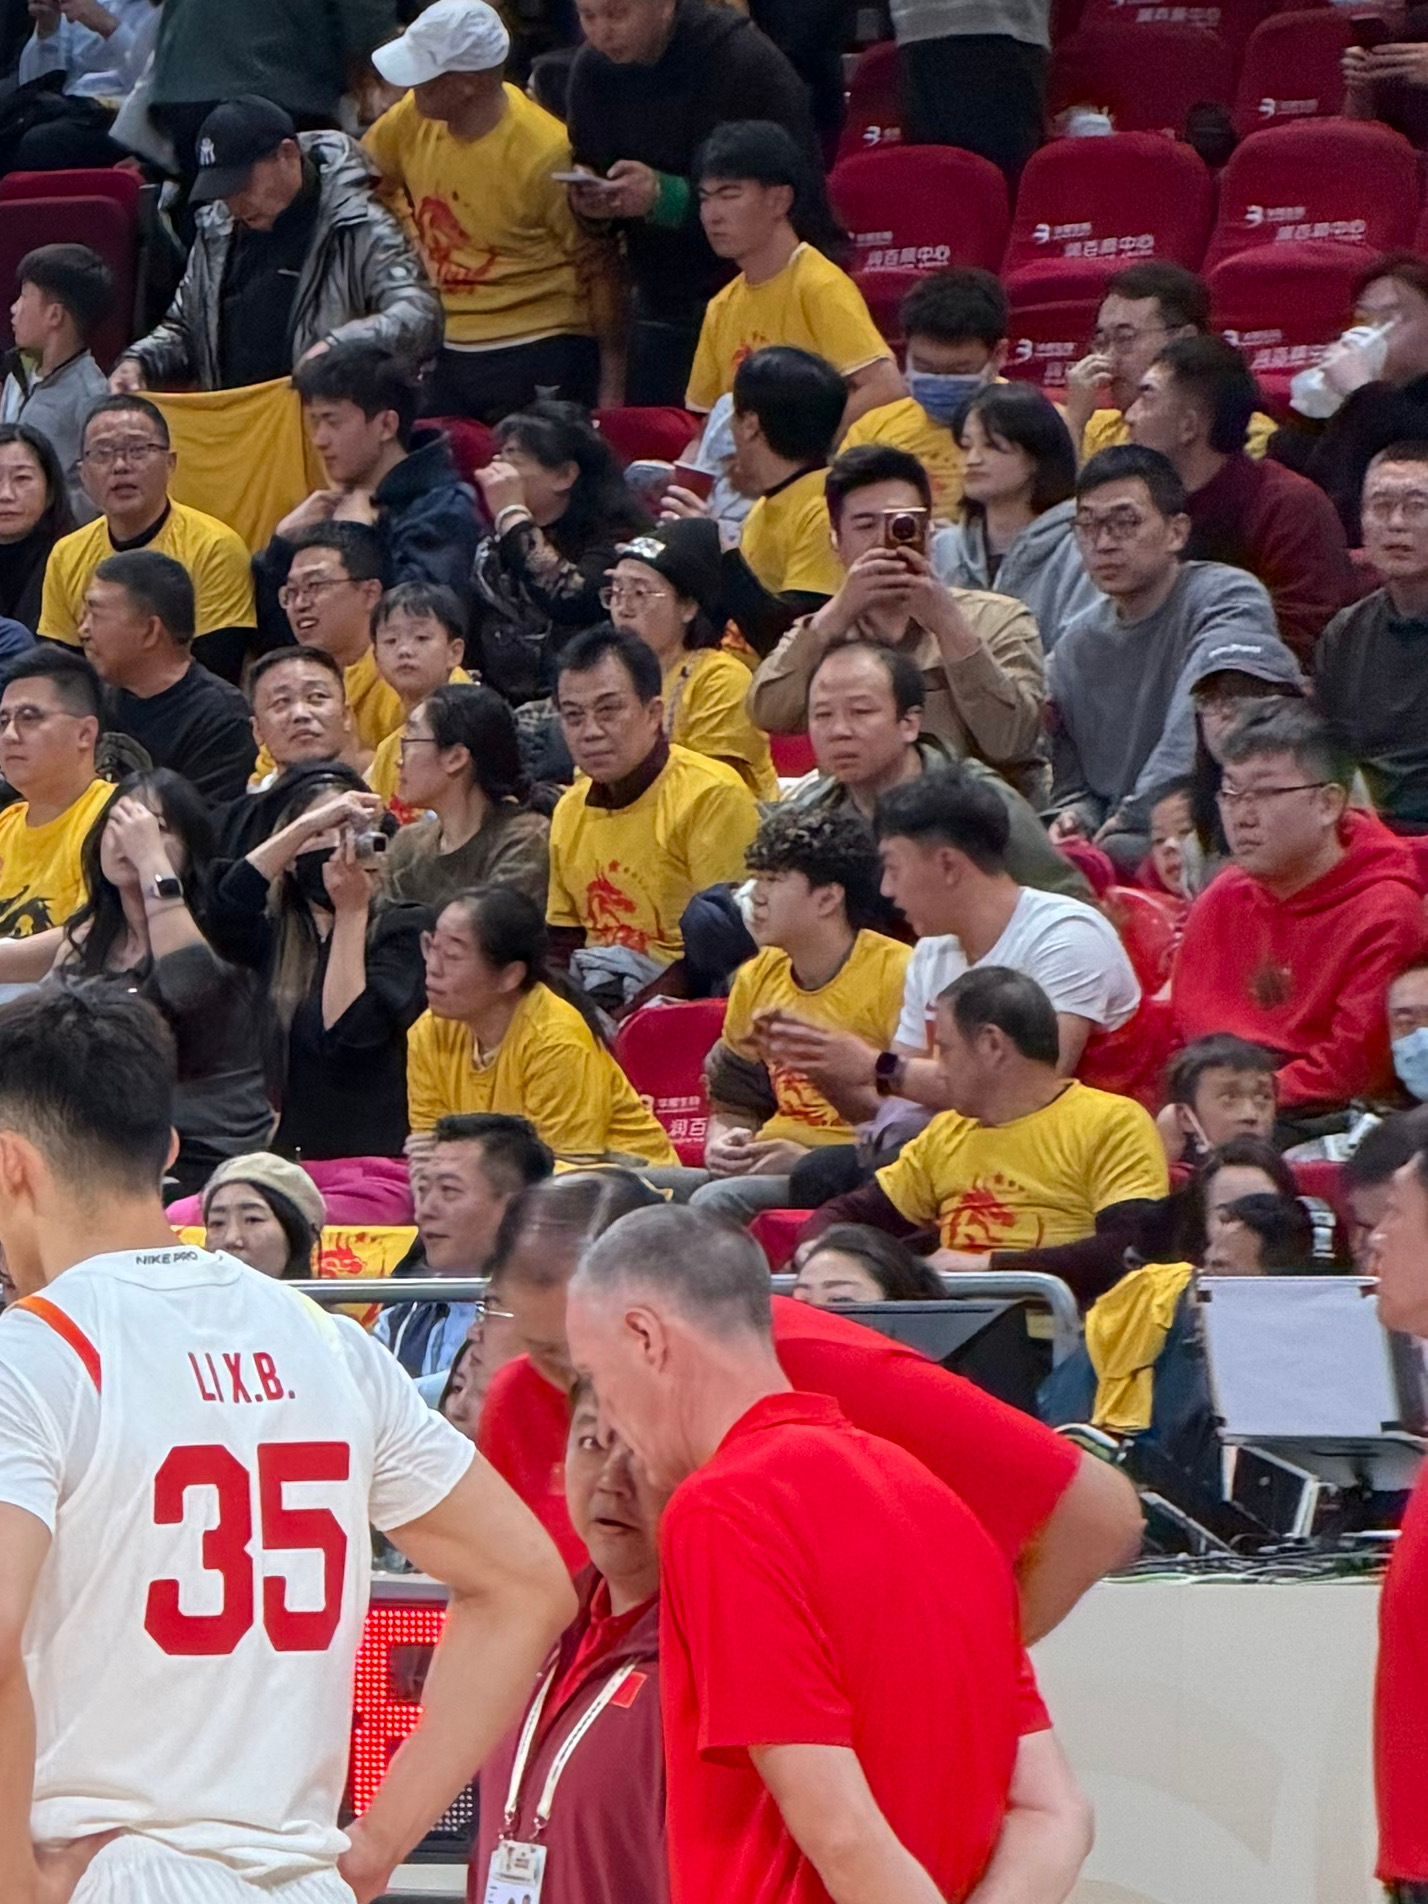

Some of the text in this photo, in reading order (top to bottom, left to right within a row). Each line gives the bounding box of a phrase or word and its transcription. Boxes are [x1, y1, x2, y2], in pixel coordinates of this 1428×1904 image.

[135, 1250, 199, 1265] NIKE PRO
[187, 1351, 297, 1404] LI X.B.
[143, 1441, 351, 1657] 35
